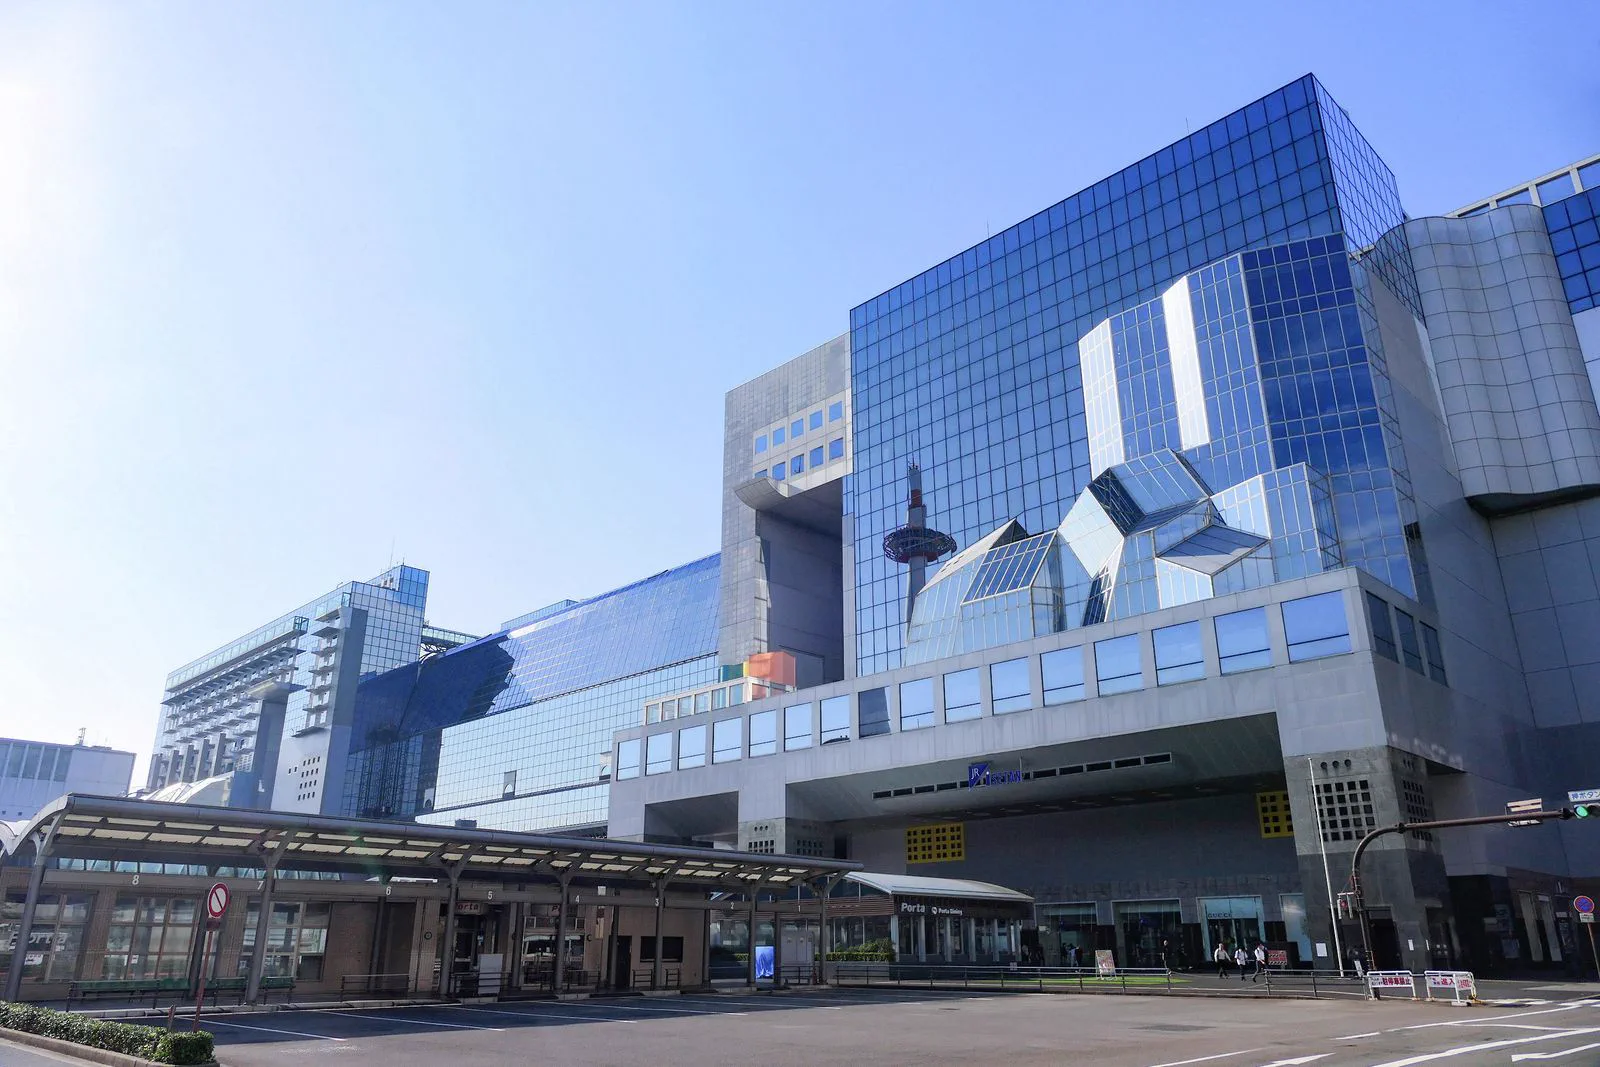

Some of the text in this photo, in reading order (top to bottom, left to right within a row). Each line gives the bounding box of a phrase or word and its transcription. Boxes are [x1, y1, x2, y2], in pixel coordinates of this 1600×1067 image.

[971, 767, 980, 780] JR
[132, 874, 140, 885] 8
[256, 880, 264, 890] 7
[386, 886, 392, 896] 6
[488, 891, 493, 900] 5
[575, 895, 580, 903] 4
[654, 898, 659, 907] 3
[456, 902, 479, 911] orta
[901, 902, 925, 913] Porta
